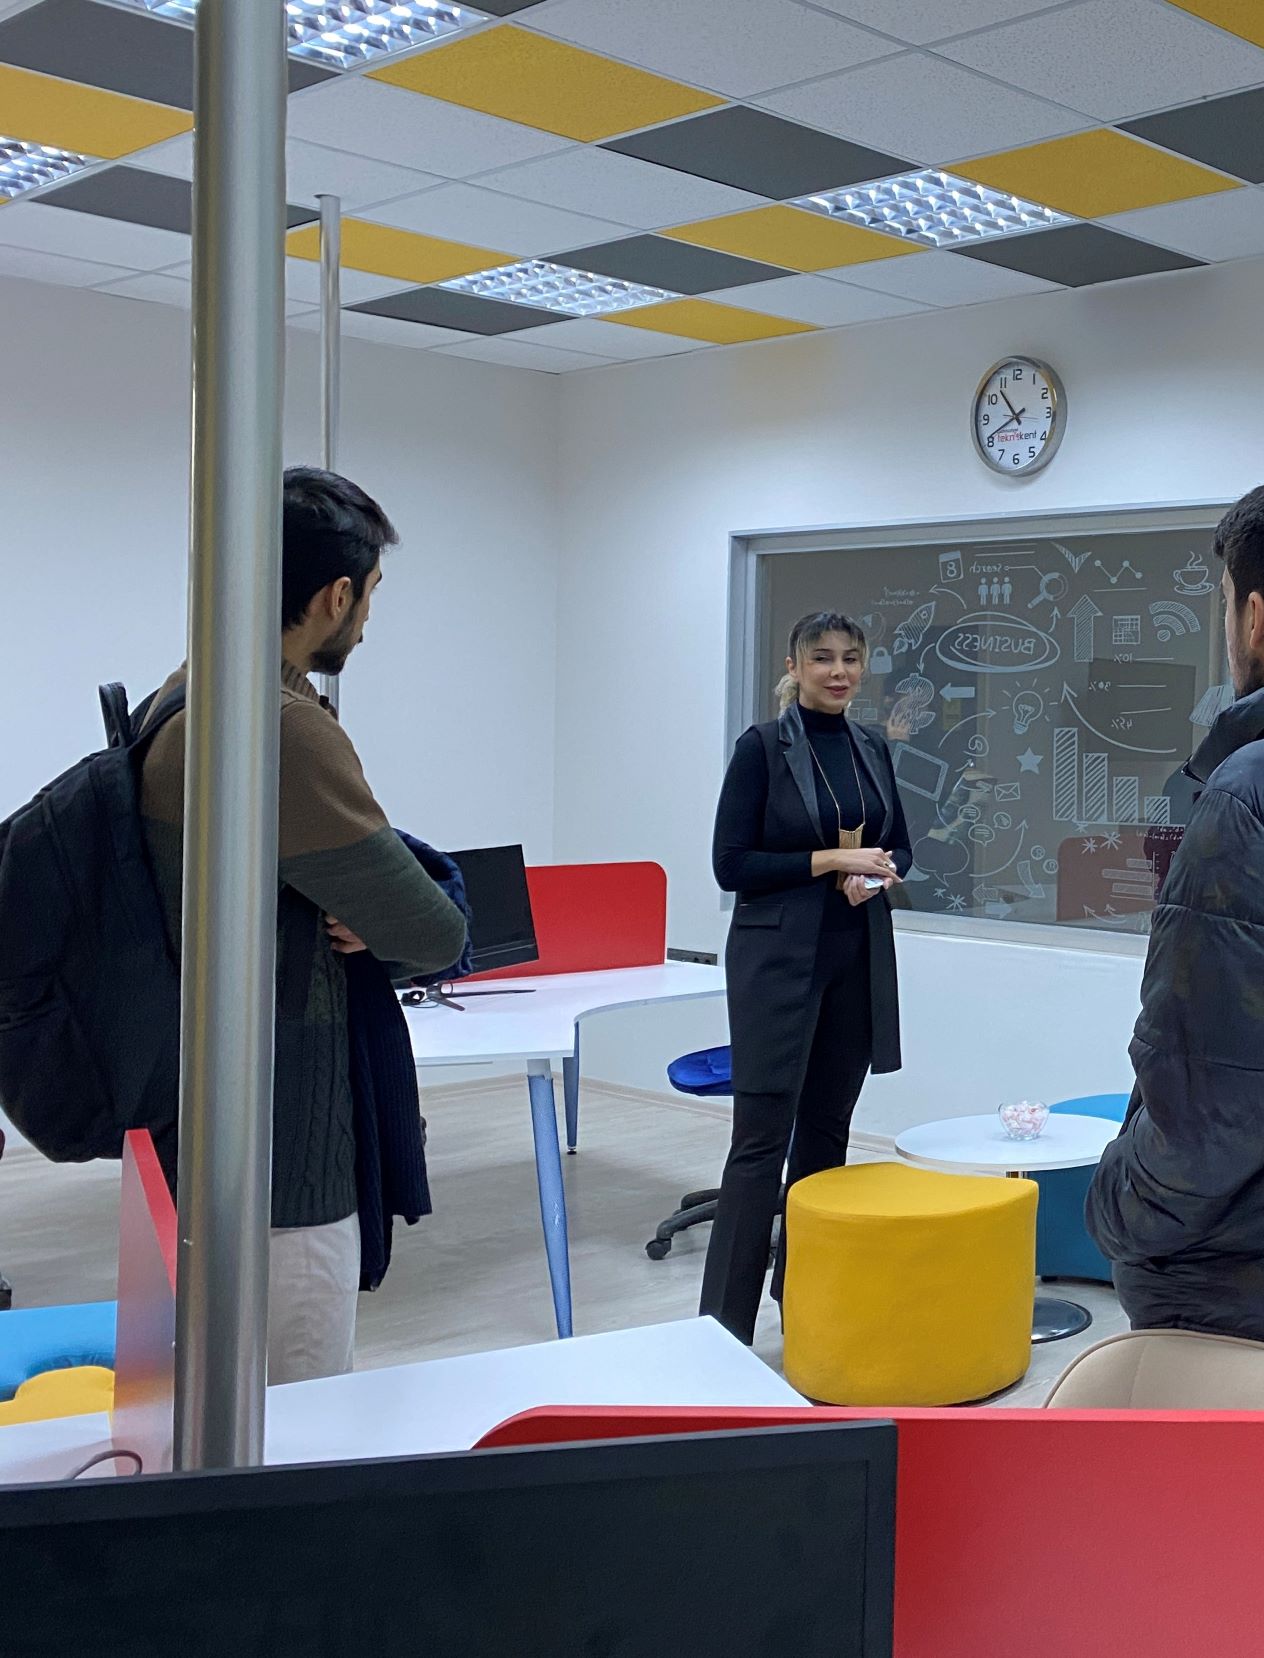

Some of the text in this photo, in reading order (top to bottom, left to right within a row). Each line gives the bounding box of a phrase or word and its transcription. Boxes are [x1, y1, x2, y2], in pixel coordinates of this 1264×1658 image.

[1012, 368, 1023, 381] 12
[1000, 377, 1007, 388] 11
[1041, 388, 1048, 399] 2
[987, 394, 998, 405] 10
[1045, 407, 1051, 418] 3
[983, 414, 990, 425] 9
[987, 436, 995, 447] 8
[1040, 431, 1047, 441] 4
[998, 449, 1005, 460] 7
[1028, 446, 1035, 458] 5
[1012, 453, 1020, 464] 6
